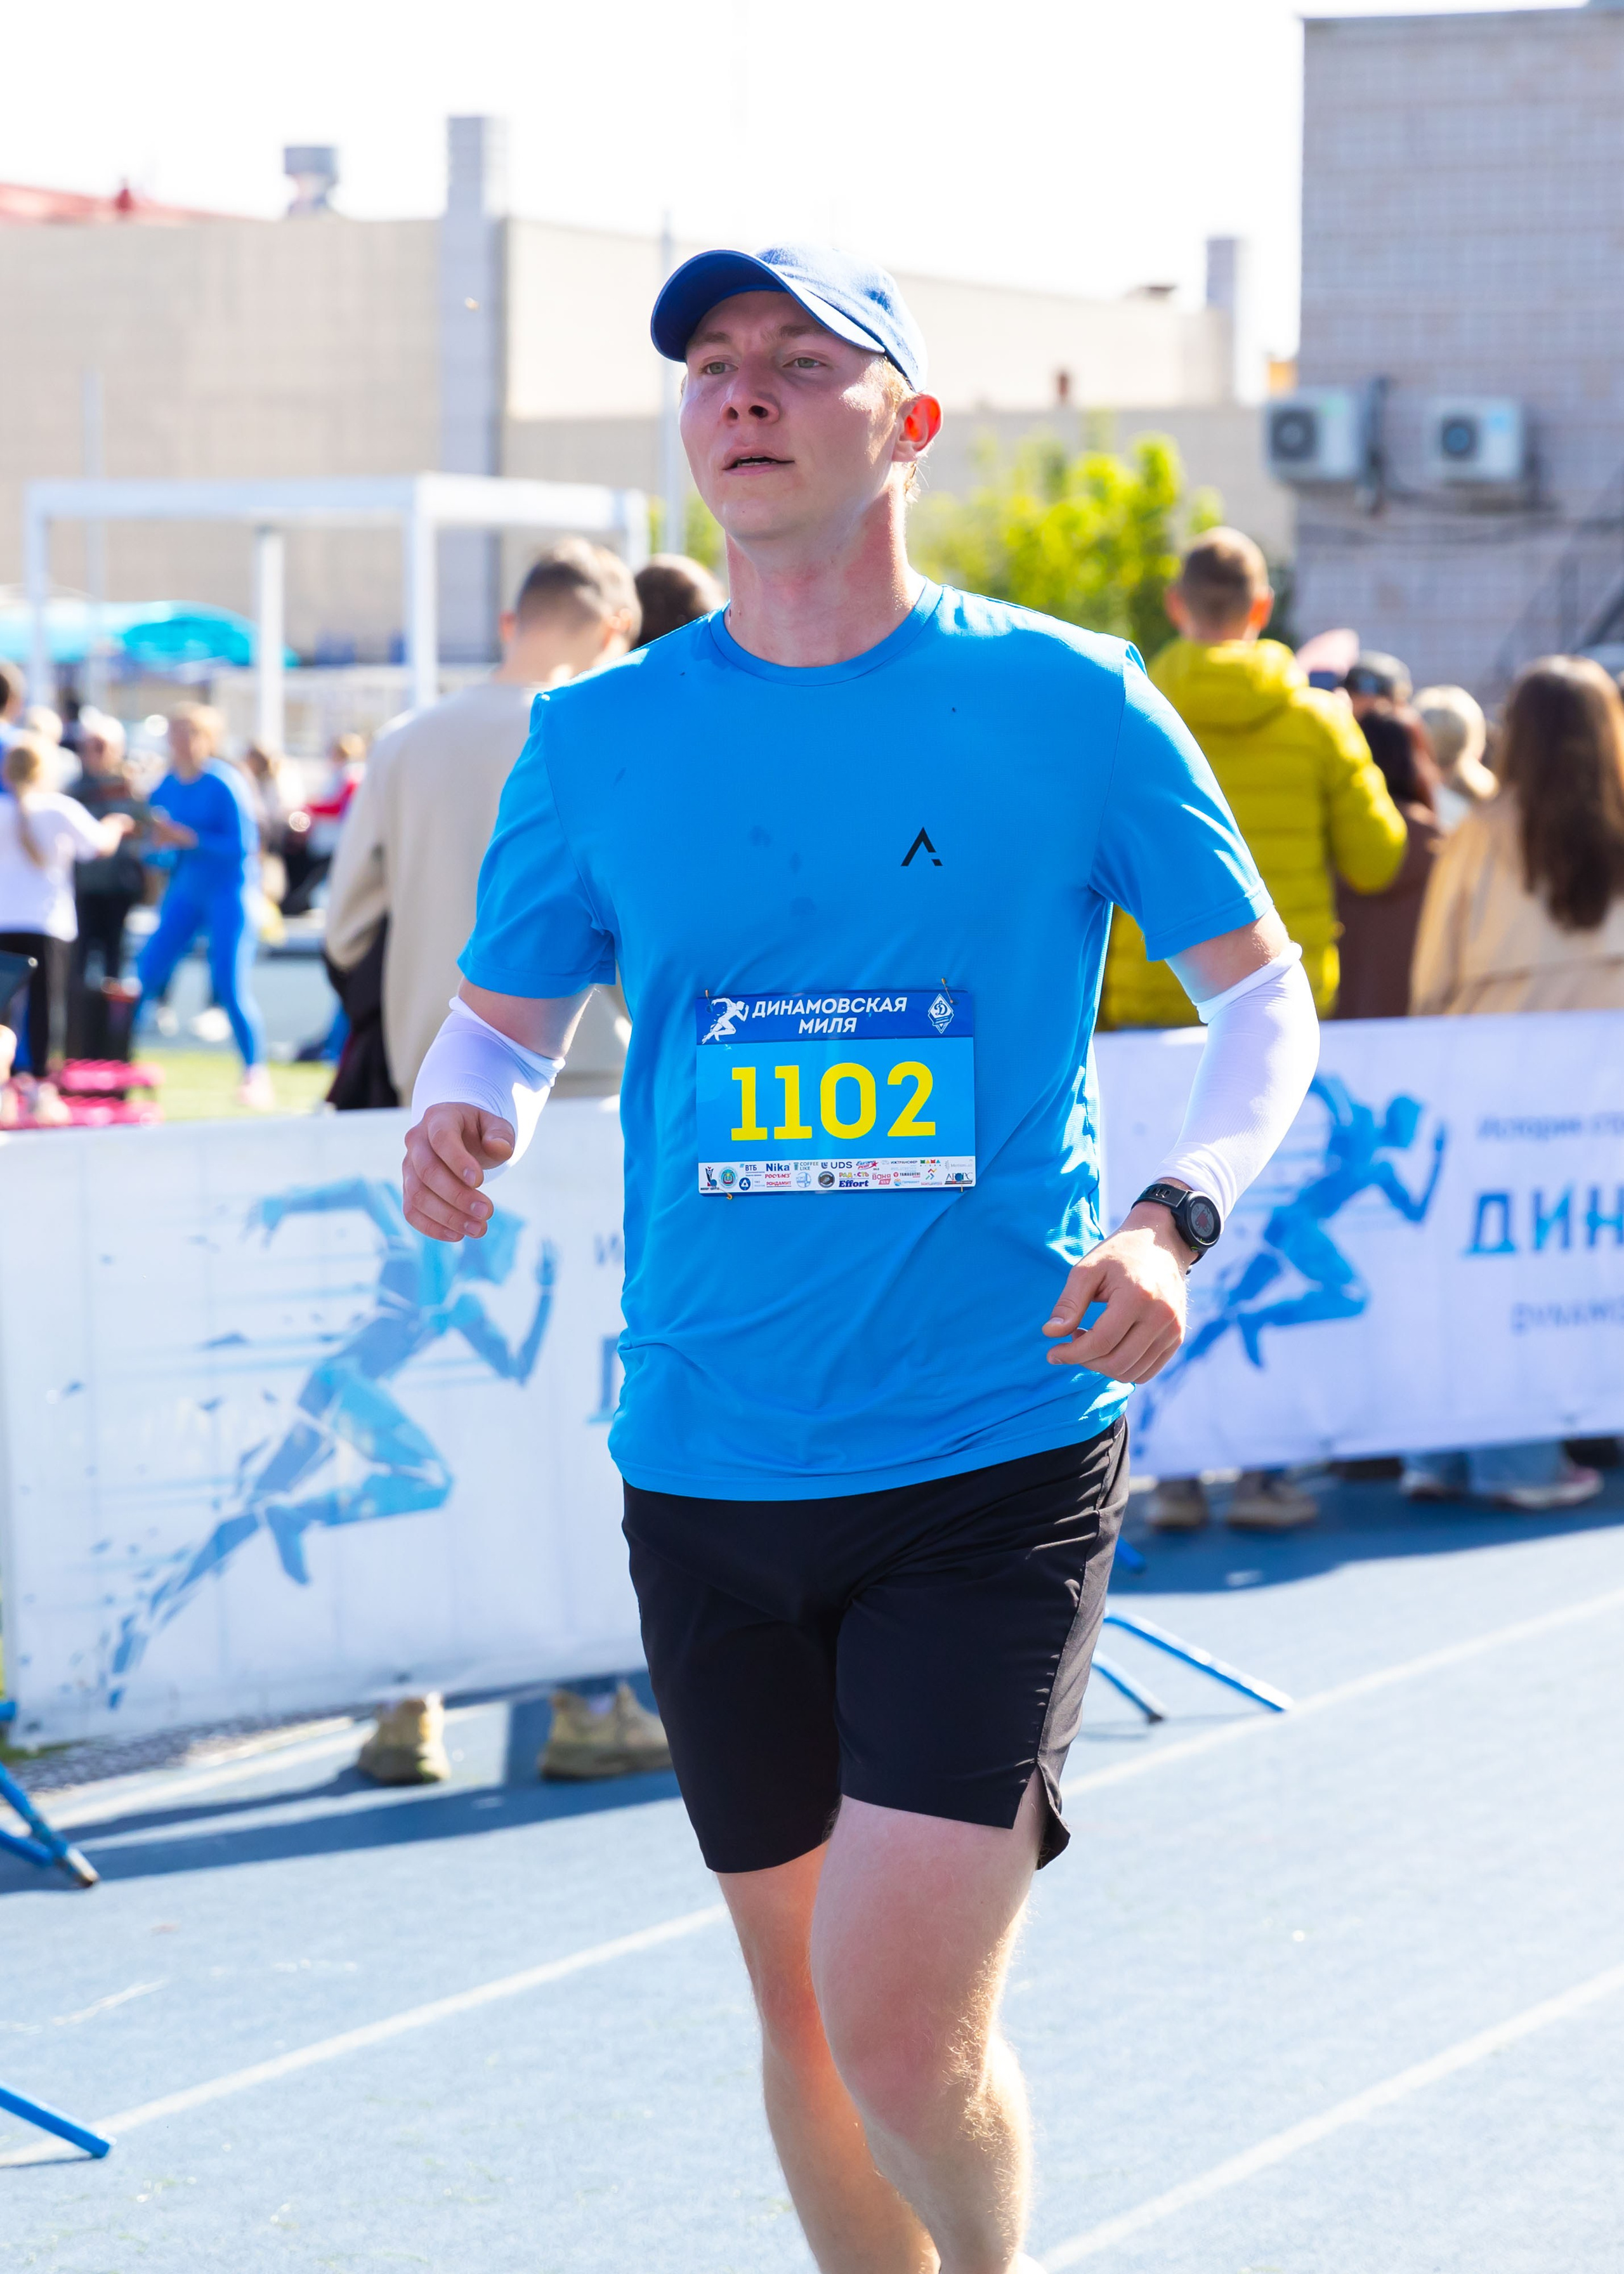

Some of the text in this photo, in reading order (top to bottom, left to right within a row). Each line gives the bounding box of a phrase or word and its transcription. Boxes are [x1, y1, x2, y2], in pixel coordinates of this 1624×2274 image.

[752, 997, 907, 1018] ДИНАМОВСКАЯ
[798, 1017, 857, 1034] МИЛЯ
[731, 1061, 936, 1141] 1102
[766, 1163, 790, 1171] Nika
